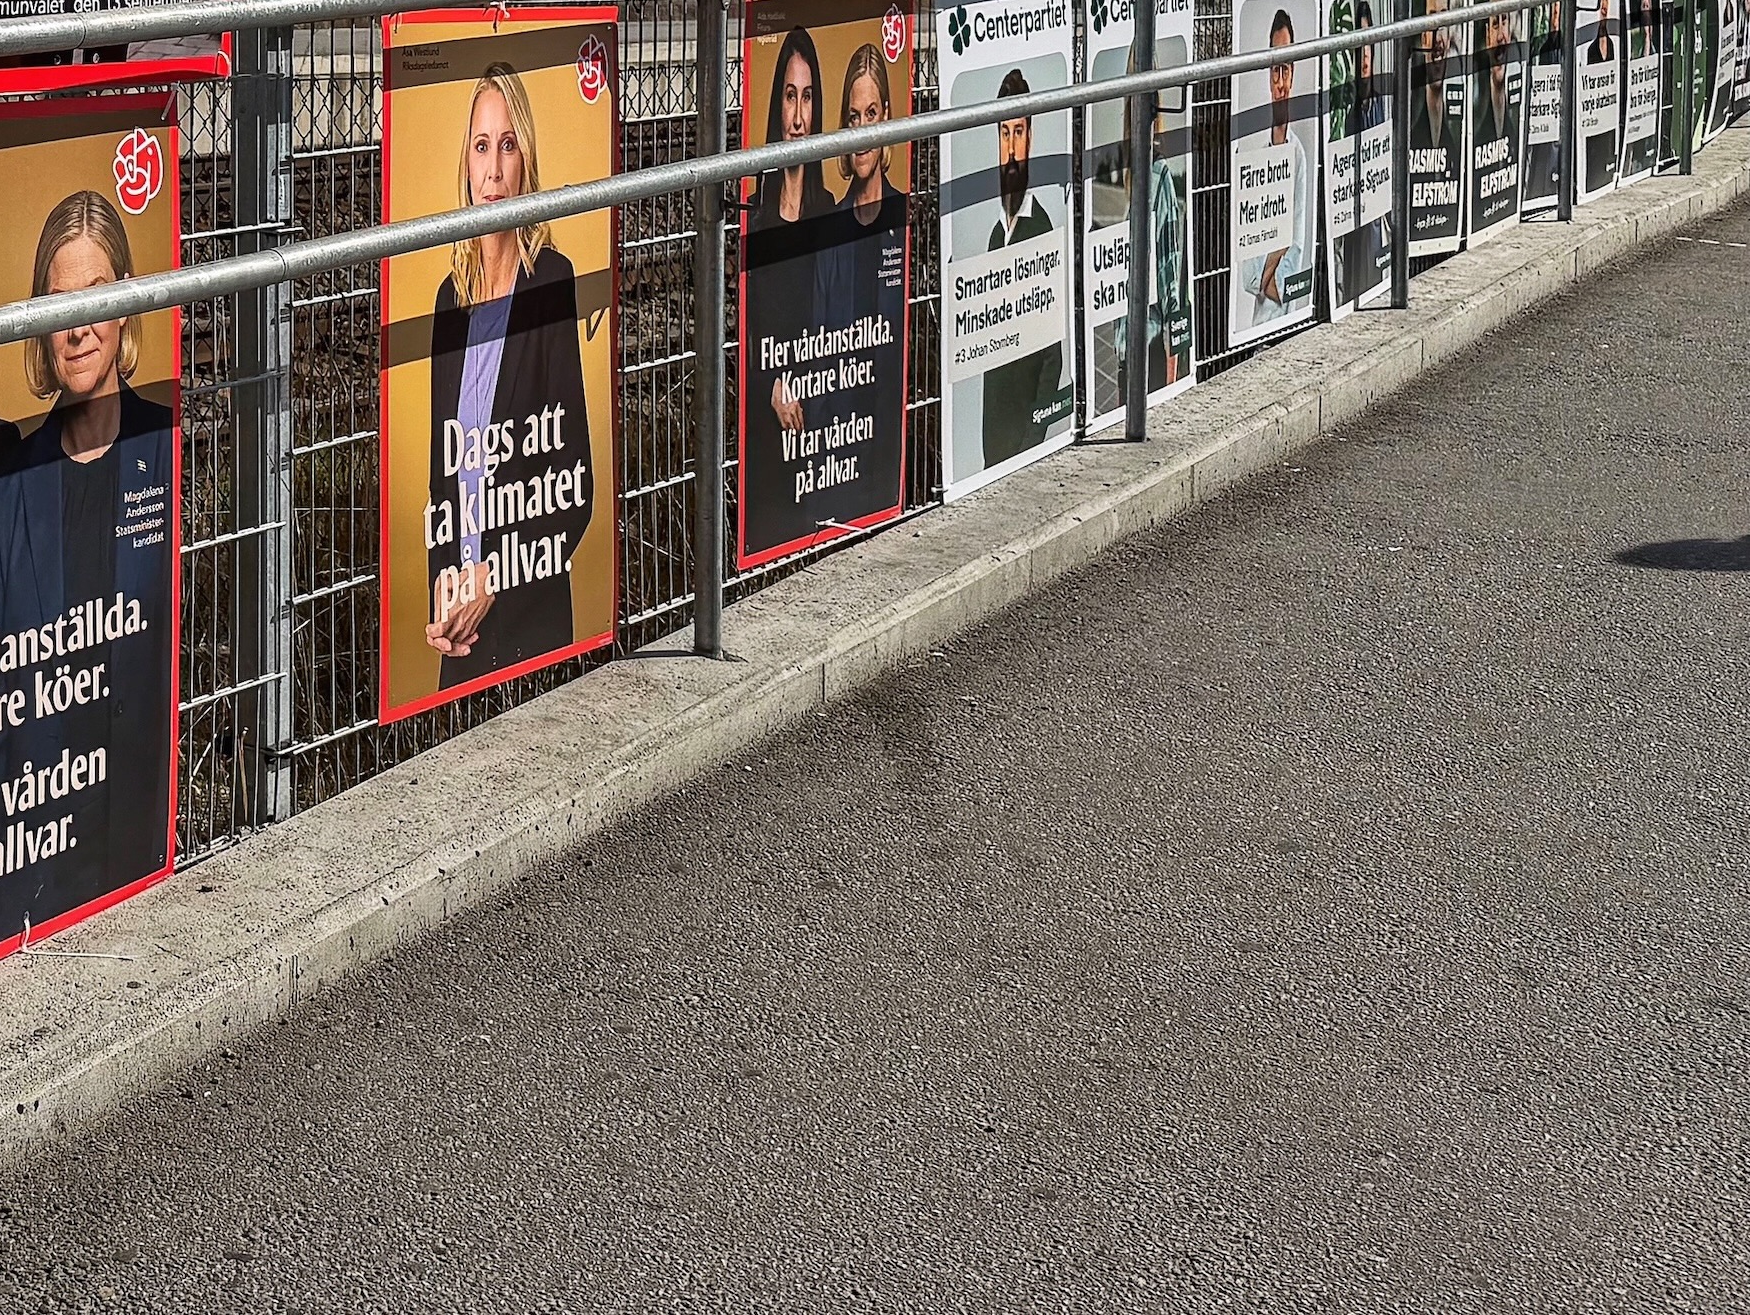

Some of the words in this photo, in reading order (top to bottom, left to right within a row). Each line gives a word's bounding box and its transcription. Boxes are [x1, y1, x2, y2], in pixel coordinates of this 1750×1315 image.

[1240, 164, 1265, 190] Färre
[1239, 201, 1258, 226] Mer
[955, 267, 1012, 301] Smartare
[1014, 249, 1060, 285] lösningar.
[955, 302, 1013, 337] Minskade
[1015, 286, 1055, 316] utsläpp.
[761, 336, 789, 371] Fler
[793, 314, 893, 362] vårdanställda.
[781, 365, 835, 405] Kortare
[839, 358, 875, 389] köer.
[443, 418, 515, 477] Dags
[522, 402, 566, 458] att
[781, 428, 797, 462] Vi
[800, 425, 822, 457] tar
[824, 414, 873, 449] vården
[424, 496, 454, 550] ta
[459, 459, 586, 539] klimatet
[795, 459, 815, 503] på
[817, 454, 859, 490] allvar.
[440, 544, 476, 624] på
[485, 531, 572, 597] allvar.
[35, 663, 110, 718] köer.
[2, 747, 107, 816] vården
